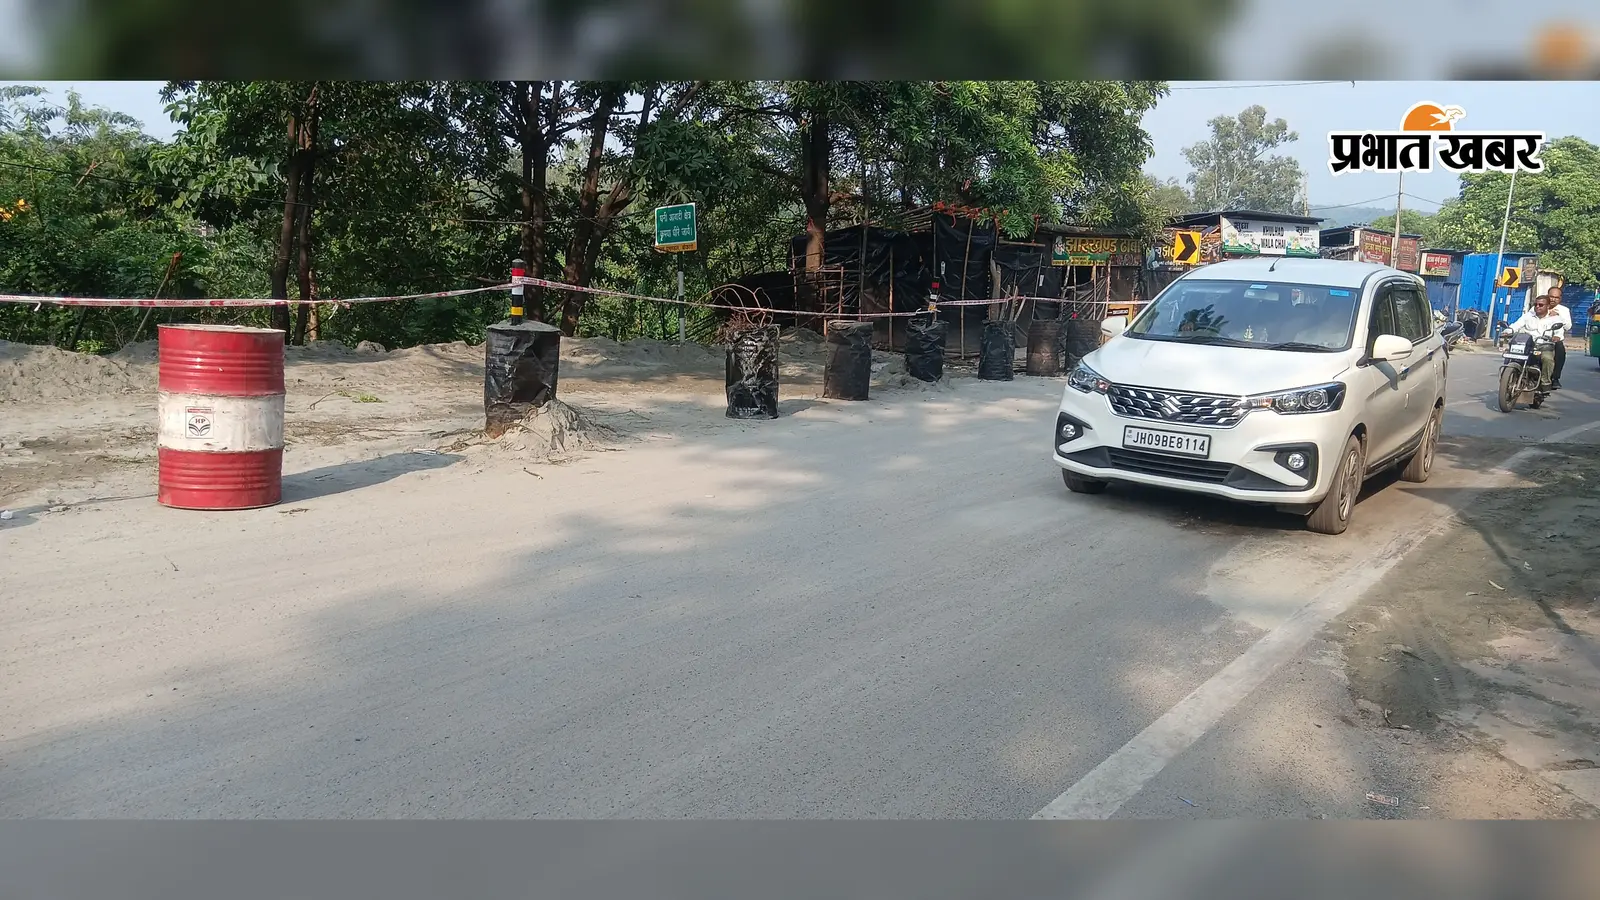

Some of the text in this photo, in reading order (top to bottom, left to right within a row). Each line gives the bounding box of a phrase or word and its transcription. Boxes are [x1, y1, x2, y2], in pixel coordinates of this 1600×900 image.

[1065, 237, 1118, 253] झारखण्ड
[1260, 238, 1286, 249] WALA CHAI
[1133, 432, 1205, 451] JH09BE8114
